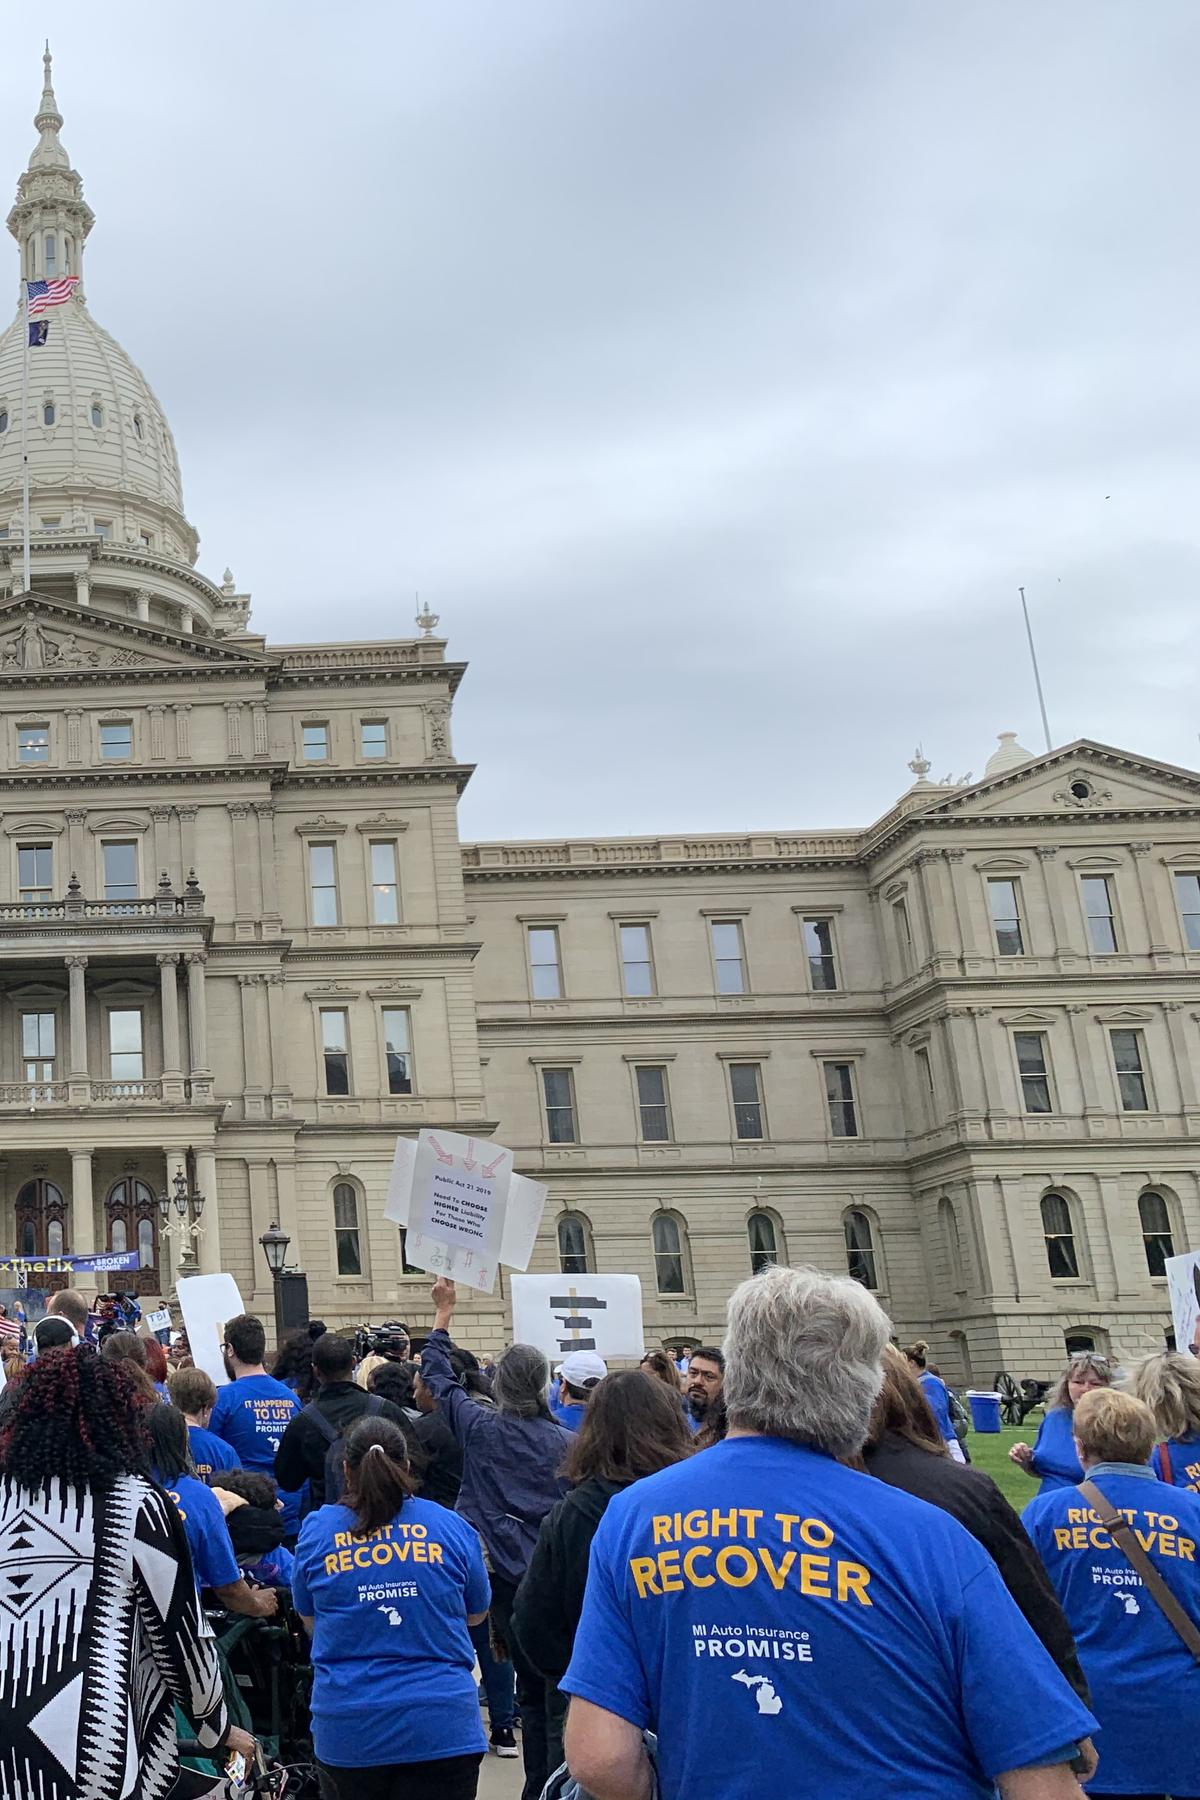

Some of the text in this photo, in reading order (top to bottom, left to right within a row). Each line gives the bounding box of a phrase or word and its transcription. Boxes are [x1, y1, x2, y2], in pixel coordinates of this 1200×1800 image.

[435, 1175, 454, 1184] Public
[455, 1180, 465, 1188] Act
[476, 1186, 491, 1195] 2019
[434, 1192, 451, 1201] Need
[461, 1200, 488, 1212] CHOOSE
[434, 1200, 486, 1222] HIGHER Liability
[431, 1217, 483, 1238] CHOOSE WRONG
[448, 1213, 466, 1223] Those
[466, 1219, 481, 1228] Who
[96, 1255, 130, 1266] BROKEN
[244, 1400, 294, 1408] IT HAPPENED
[253, 1408, 270, 1420] TO
[256, 1425, 287, 1433] PROMIS
[652, 1508, 835, 1549] RIGHT TO
[1068, 1508, 1179, 1531] RIGT TO
[398, 1524, 428, 1539] TO
[1054, 1527, 1196, 1562] RECVER
[324, 1541, 444, 1576] RECOVER
[629, 1545, 873, 1606] RECOVER
[1091, 1566, 1102, 1574] MI
[1104, 1567, 1123, 1575] Auto
[358, 1580, 417, 1592] MI Auto Insurance
[1092, 1574, 1143, 1586] PROMI
[359, 1586, 418, 1602] PROMISE
[692, 1623, 809, 1641] MI Auto Insurance
[694, 1639, 813, 1662] PROMISE
